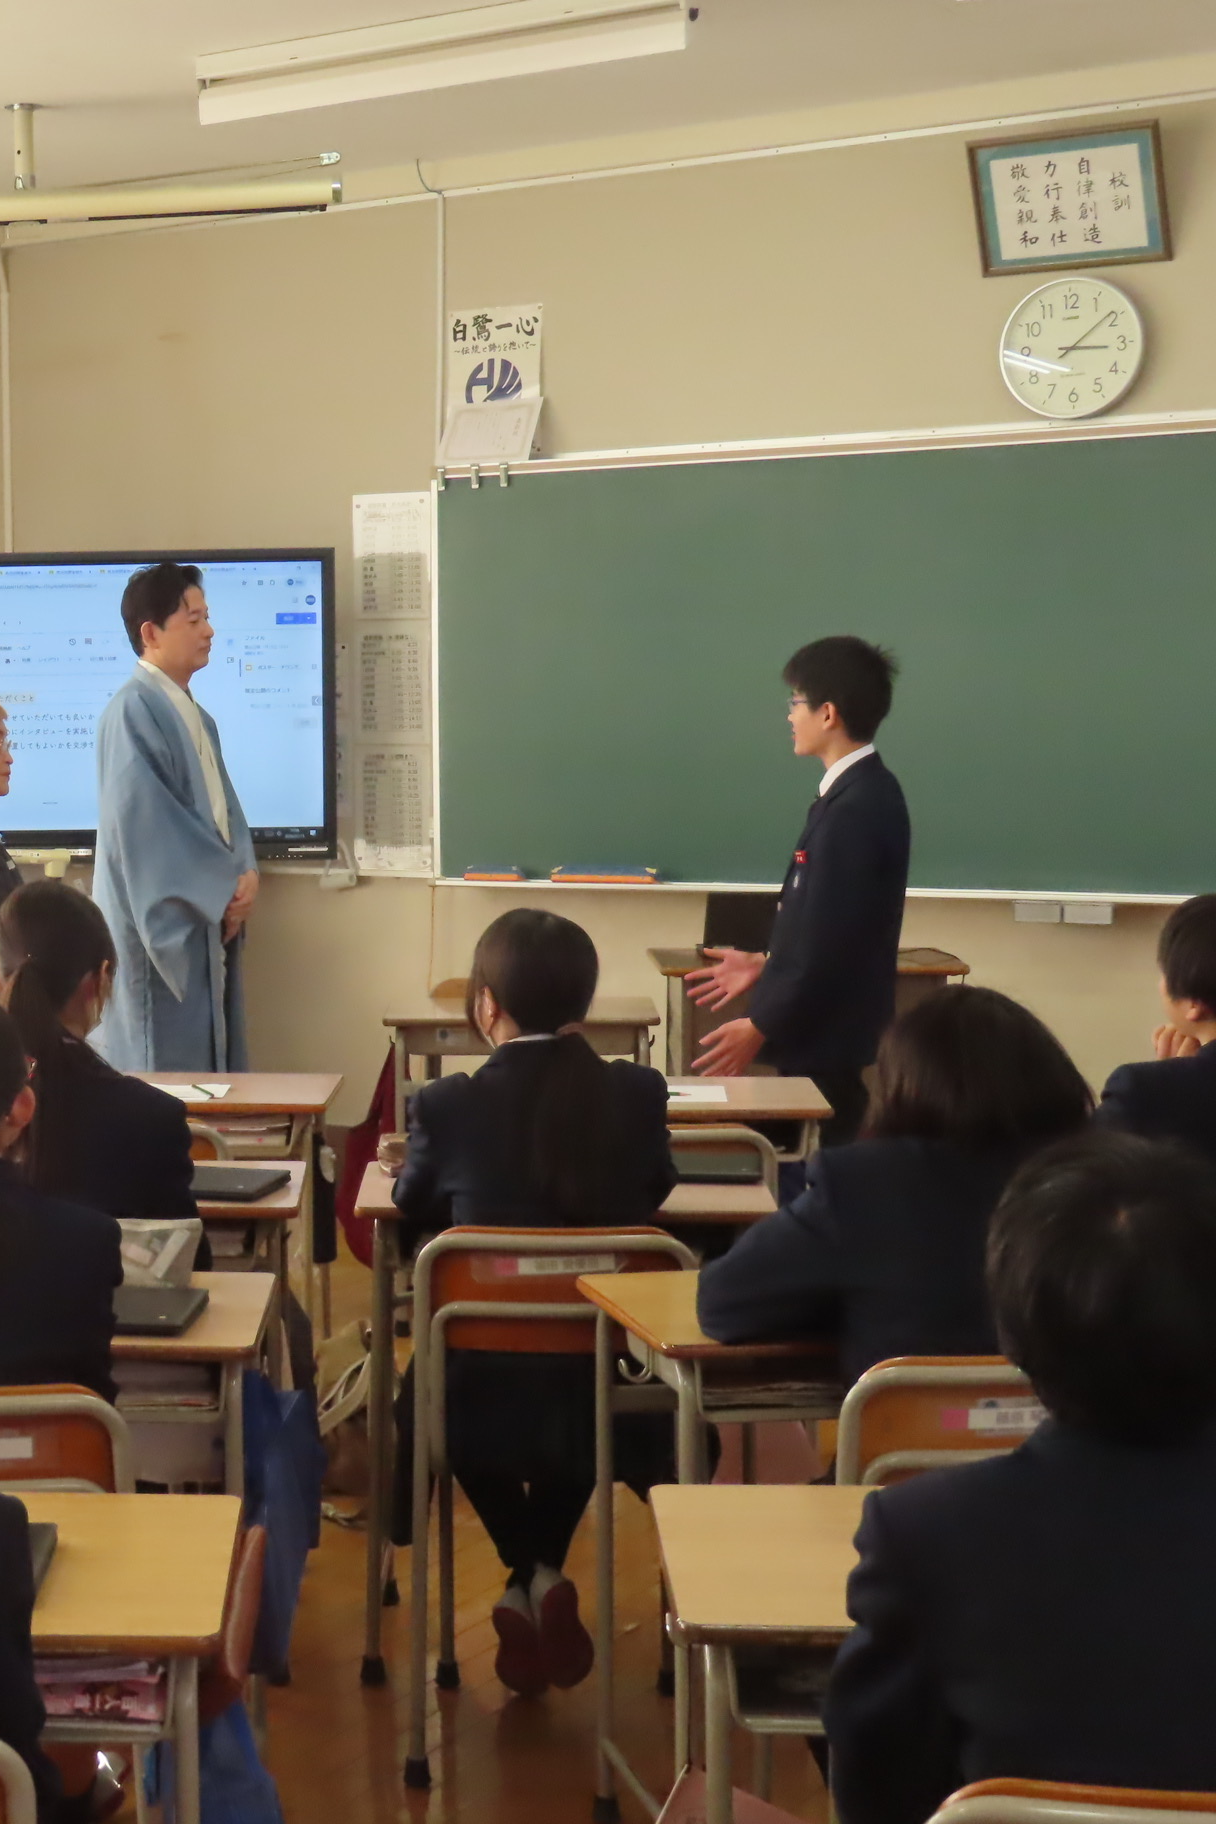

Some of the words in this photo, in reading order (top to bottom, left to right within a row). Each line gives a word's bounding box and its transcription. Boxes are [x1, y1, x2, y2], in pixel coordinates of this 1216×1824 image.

[1108, 171, 1131, 210] 校訓
[1010, 163, 1040, 248] 敬愛親和
[1043, 160, 1068, 247] 力行奉仕
[1076, 156, 1103, 245] 自律創造
[1063, 293, 1080, 310] 12
[1092, 297, 1099, 312] 1
[1040, 303, 1054, 319] 11
[1107, 311, 1118, 327] 2
[452, 313, 540, 343] 白鷺一心
[1025, 321, 1042, 338] 10
[1117, 335, 1127, 351] 3
[1020, 346, 1032, 362] 9
[1109, 361, 1119, 375] 4
[1028, 369, 1040, 385] 8
[1092, 377, 1103, 393] 5
[1046, 383, 1057, 399] 7
[1068, 387, 1079, 403] 6
